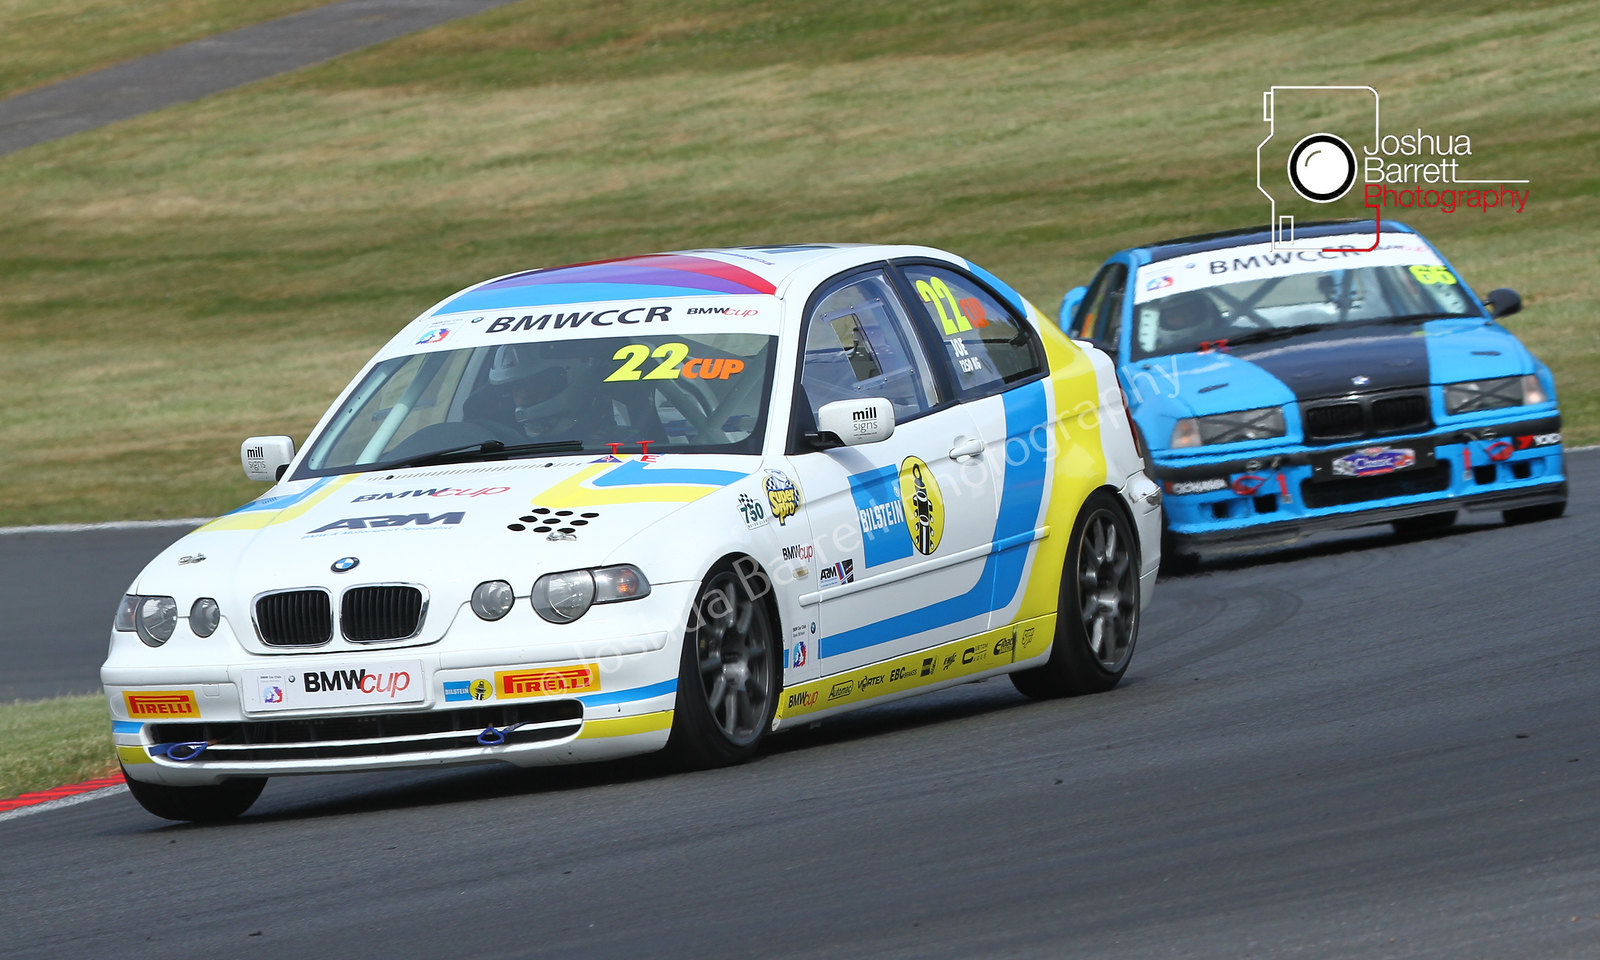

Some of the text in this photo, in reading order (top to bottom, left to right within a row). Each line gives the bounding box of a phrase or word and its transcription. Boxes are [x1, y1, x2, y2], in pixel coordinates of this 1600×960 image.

[1209, 244, 1362, 275] BMWCCR
[1408, 265, 1458, 286] 66
[915, 276, 990, 336] 22 CUP
[485, 306, 673, 334] BMWCCR
[950, 337, 969, 357] JOE
[602, 342, 745, 382] 22 CUP
[852, 406, 877, 420] mill
[853, 421, 878, 433] signs
[247, 446, 264, 458] mill
[248, 460, 266, 471] signs
[740, 502, 764, 524] 750
[858, 501, 905, 534] BILSTEIN
[502, 669, 591, 694] PIRELLI
[890, 667, 906, 682] EBC
[127, 695, 193, 714] PIRELLI
